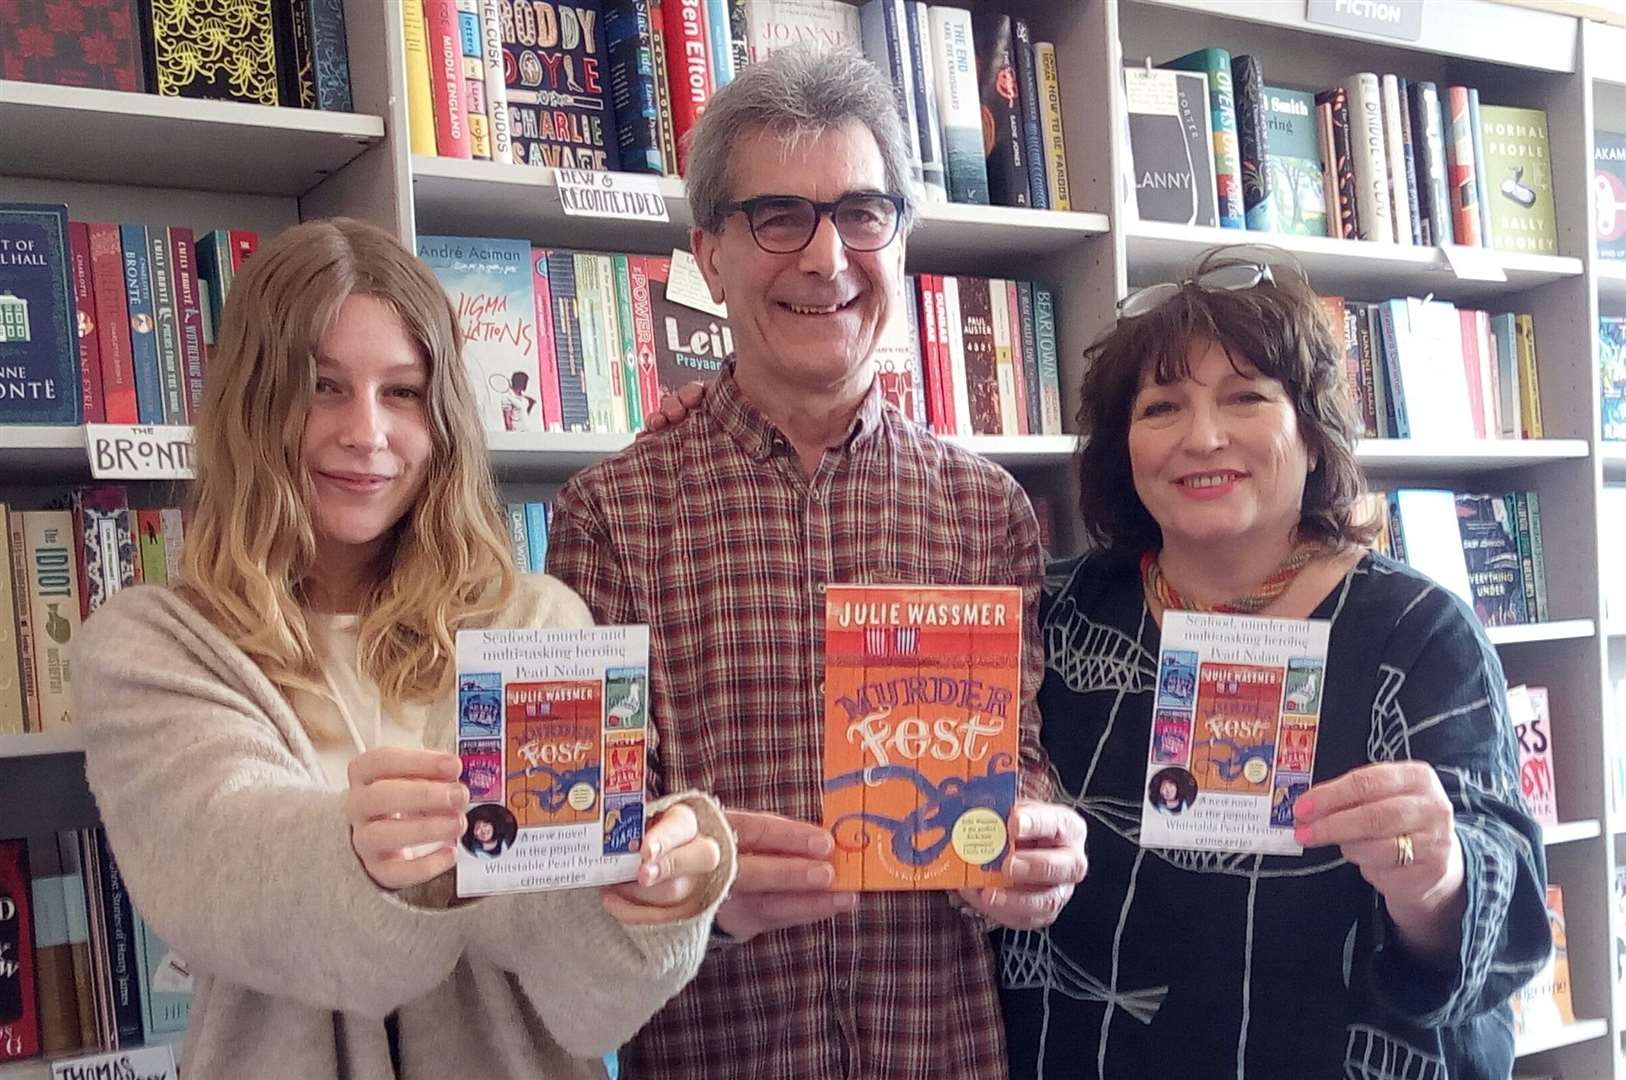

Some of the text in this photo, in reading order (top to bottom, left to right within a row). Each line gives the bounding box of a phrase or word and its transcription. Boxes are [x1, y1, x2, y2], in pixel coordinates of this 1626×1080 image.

[1335, 0, 1401, 22] FICTION
[499, 0, 596, 54] RODDY
[487, 28, 500, 69] CUSK
[681, 0, 707, 103] Ben Elton
[954, 23, 969, 73] THE END
[501, 48, 603, 94] DOYLE
[442, 34, 462, 140] MIDDLE ENGLAND
[1048, 84, 1058, 114] HOW
[1270, 96, 1309, 116] Smith
[494, 100, 508, 153] KUDOS
[510, 106, 604, 146] CHARLIE
[1483, 122, 1545, 139] NORMAL
[1012, 140, 1021, 167] JONES
[1489, 143, 1544, 158] PEOPLE
[559, 186, 665, 217] RECOMMENDED
[16, 239, 35, 251] OF
[154, 238, 164, 268] EMILY
[177, 240, 188, 269] EMILY
[419, 243, 521, 262] André Aciman
[11, 254, 48, 266] HALL
[632, 273, 651, 343] POWER
[963, 325, 993, 336] AUSTER
[967, 316, 986, 326] PAUL
[1036, 291, 1056, 379] BEARTOWN
[185, 324, 199, 378] WUTHERING
[131, 427, 155, 436] THE
[44, 527, 59, 544] The
[35, 547, 72, 598] IDIOT
[1469, 572, 1514, 585] VERYTHING
[1476, 585, 1505, 597] UNDER
[839, 602, 1007, 627] JULIE WASSMER
[1185, 614, 1311, 633] Seafood, murder and
[482, 629, 627, 645] Seafood, murder and
[1184, 631, 1261, 647] multi-tasking
[482, 646, 572, 661] multi-tasking
[1243, 649, 1281, 664] Nolan
[516, 665, 595, 679] Pearl Nolan
[512, 687, 593, 705] JULIE WASSMER
[834, 675, 1013, 720] MURDER
[846, 704, 1004, 768] Fest
[520, 827, 588, 843] A new novel
[528, 845, 547, 857] the
[549, 843, 592, 857] popular
[484, 855, 620, 875] Whitstable Pearl Mystery
[520, 873, 587, 887] crime series
[55, 1056, 135, 1080] THOMAS
